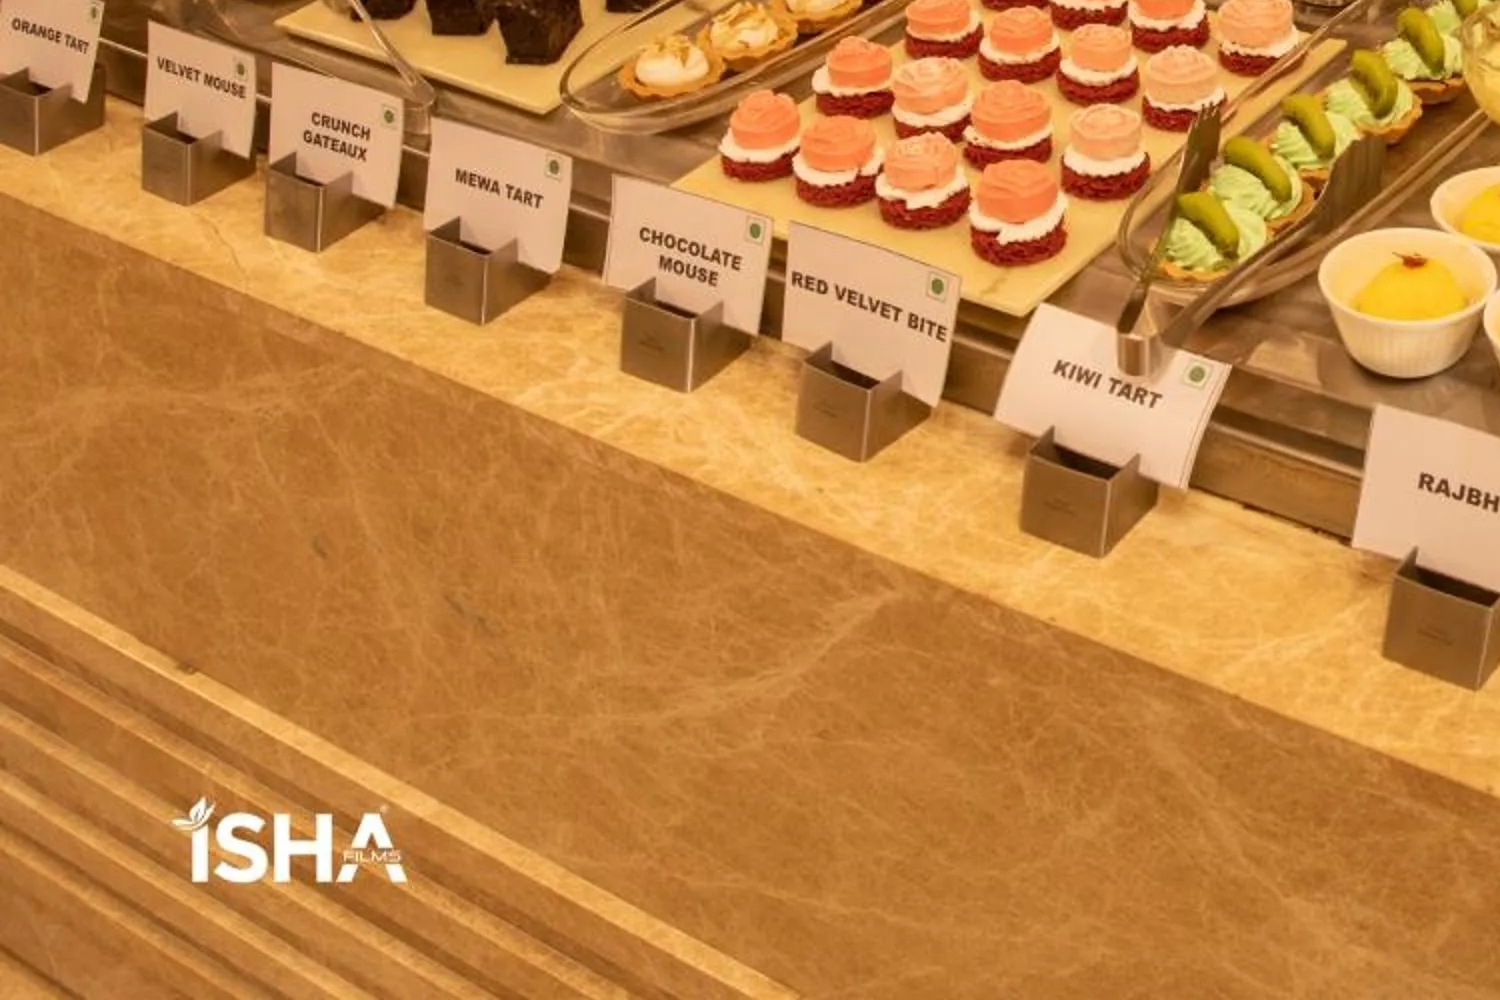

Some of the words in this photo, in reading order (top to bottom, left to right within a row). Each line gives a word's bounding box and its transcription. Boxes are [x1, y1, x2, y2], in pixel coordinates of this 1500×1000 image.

[12, 17, 61, 44] ORANGE
[65, 33, 89, 55] TART
[157, 55, 200, 82] VELVET
[203, 72, 246, 99] MOUSE
[303, 129, 367, 162] GATEAUX
[311, 111, 371, 141] CRUNCH
[455, 167, 501, 197] MEWA
[505, 183, 544, 209] TART
[639, 226, 743, 272] CHOCOLATE
[659, 253, 719, 287] MOUSE
[791, 270, 828, 295] RED
[834, 283, 904, 323] VELVET
[907, 311, 948, 343] BITE
[1052, 359, 1103, 390] KIWI
[1108, 376, 1164, 409] TART
